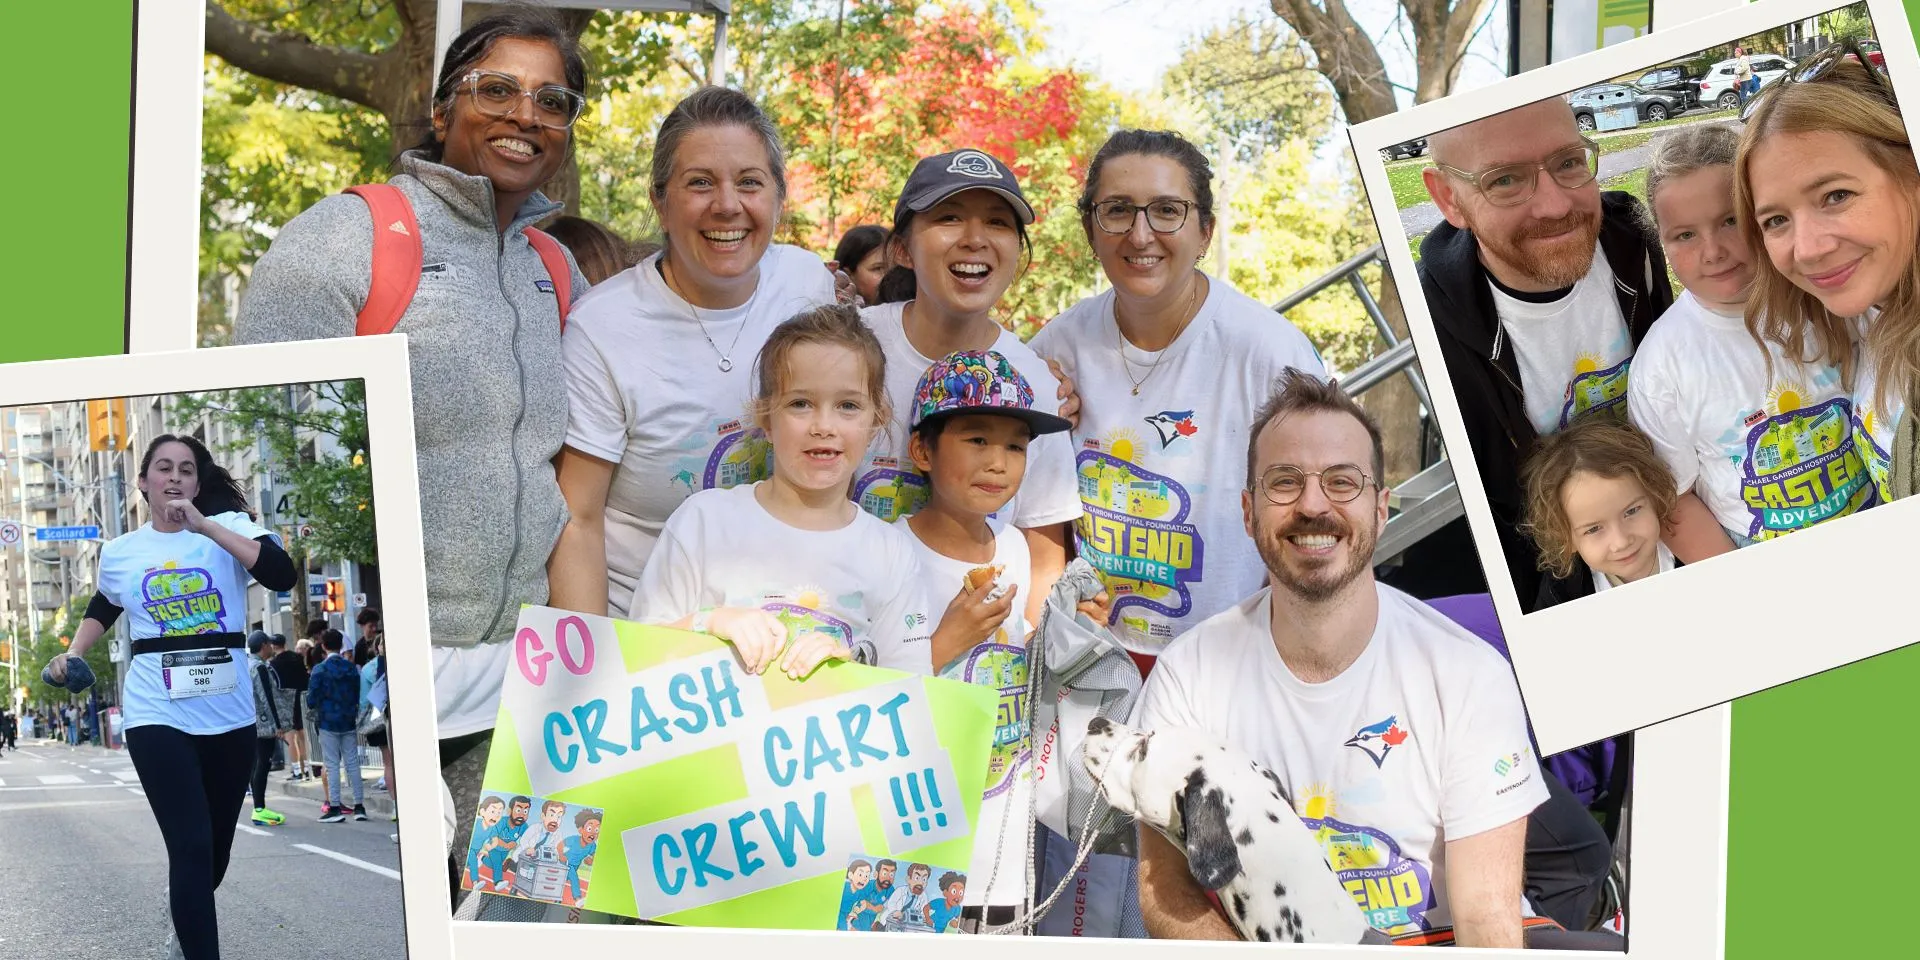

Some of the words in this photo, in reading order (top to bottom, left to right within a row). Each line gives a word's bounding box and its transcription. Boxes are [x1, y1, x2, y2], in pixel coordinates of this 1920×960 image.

[1744, 476, 1771, 486] CHAEL
[1772, 465, 1804, 481] GARRON
[1804, 452, 1839, 470] HOSPITAL
[1744, 467, 1827, 509] EAST
[44, 529, 85, 538] Scollard
[1088, 506, 1113, 519] GARRON
[1113, 513, 1145, 527] HOSPITAL
[1145, 520, 1194, 533] FOUNDATION
[1128, 525, 1193, 569] END
[147, 600, 188, 622] EAST
[189, 594, 220, 615] END
[515, 615, 595, 686] GO
[189, 668, 214, 676] CINDY
[543, 659, 744, 774] CRASH
[763, 692, 910, 787] CART
[652, 791, 827, 896] CREW
[1359, 860, 1413, 878] FOUNDATION
[1073, 878, 1086, 936] ROGERS
[1343, 870, 1423, 912] END
